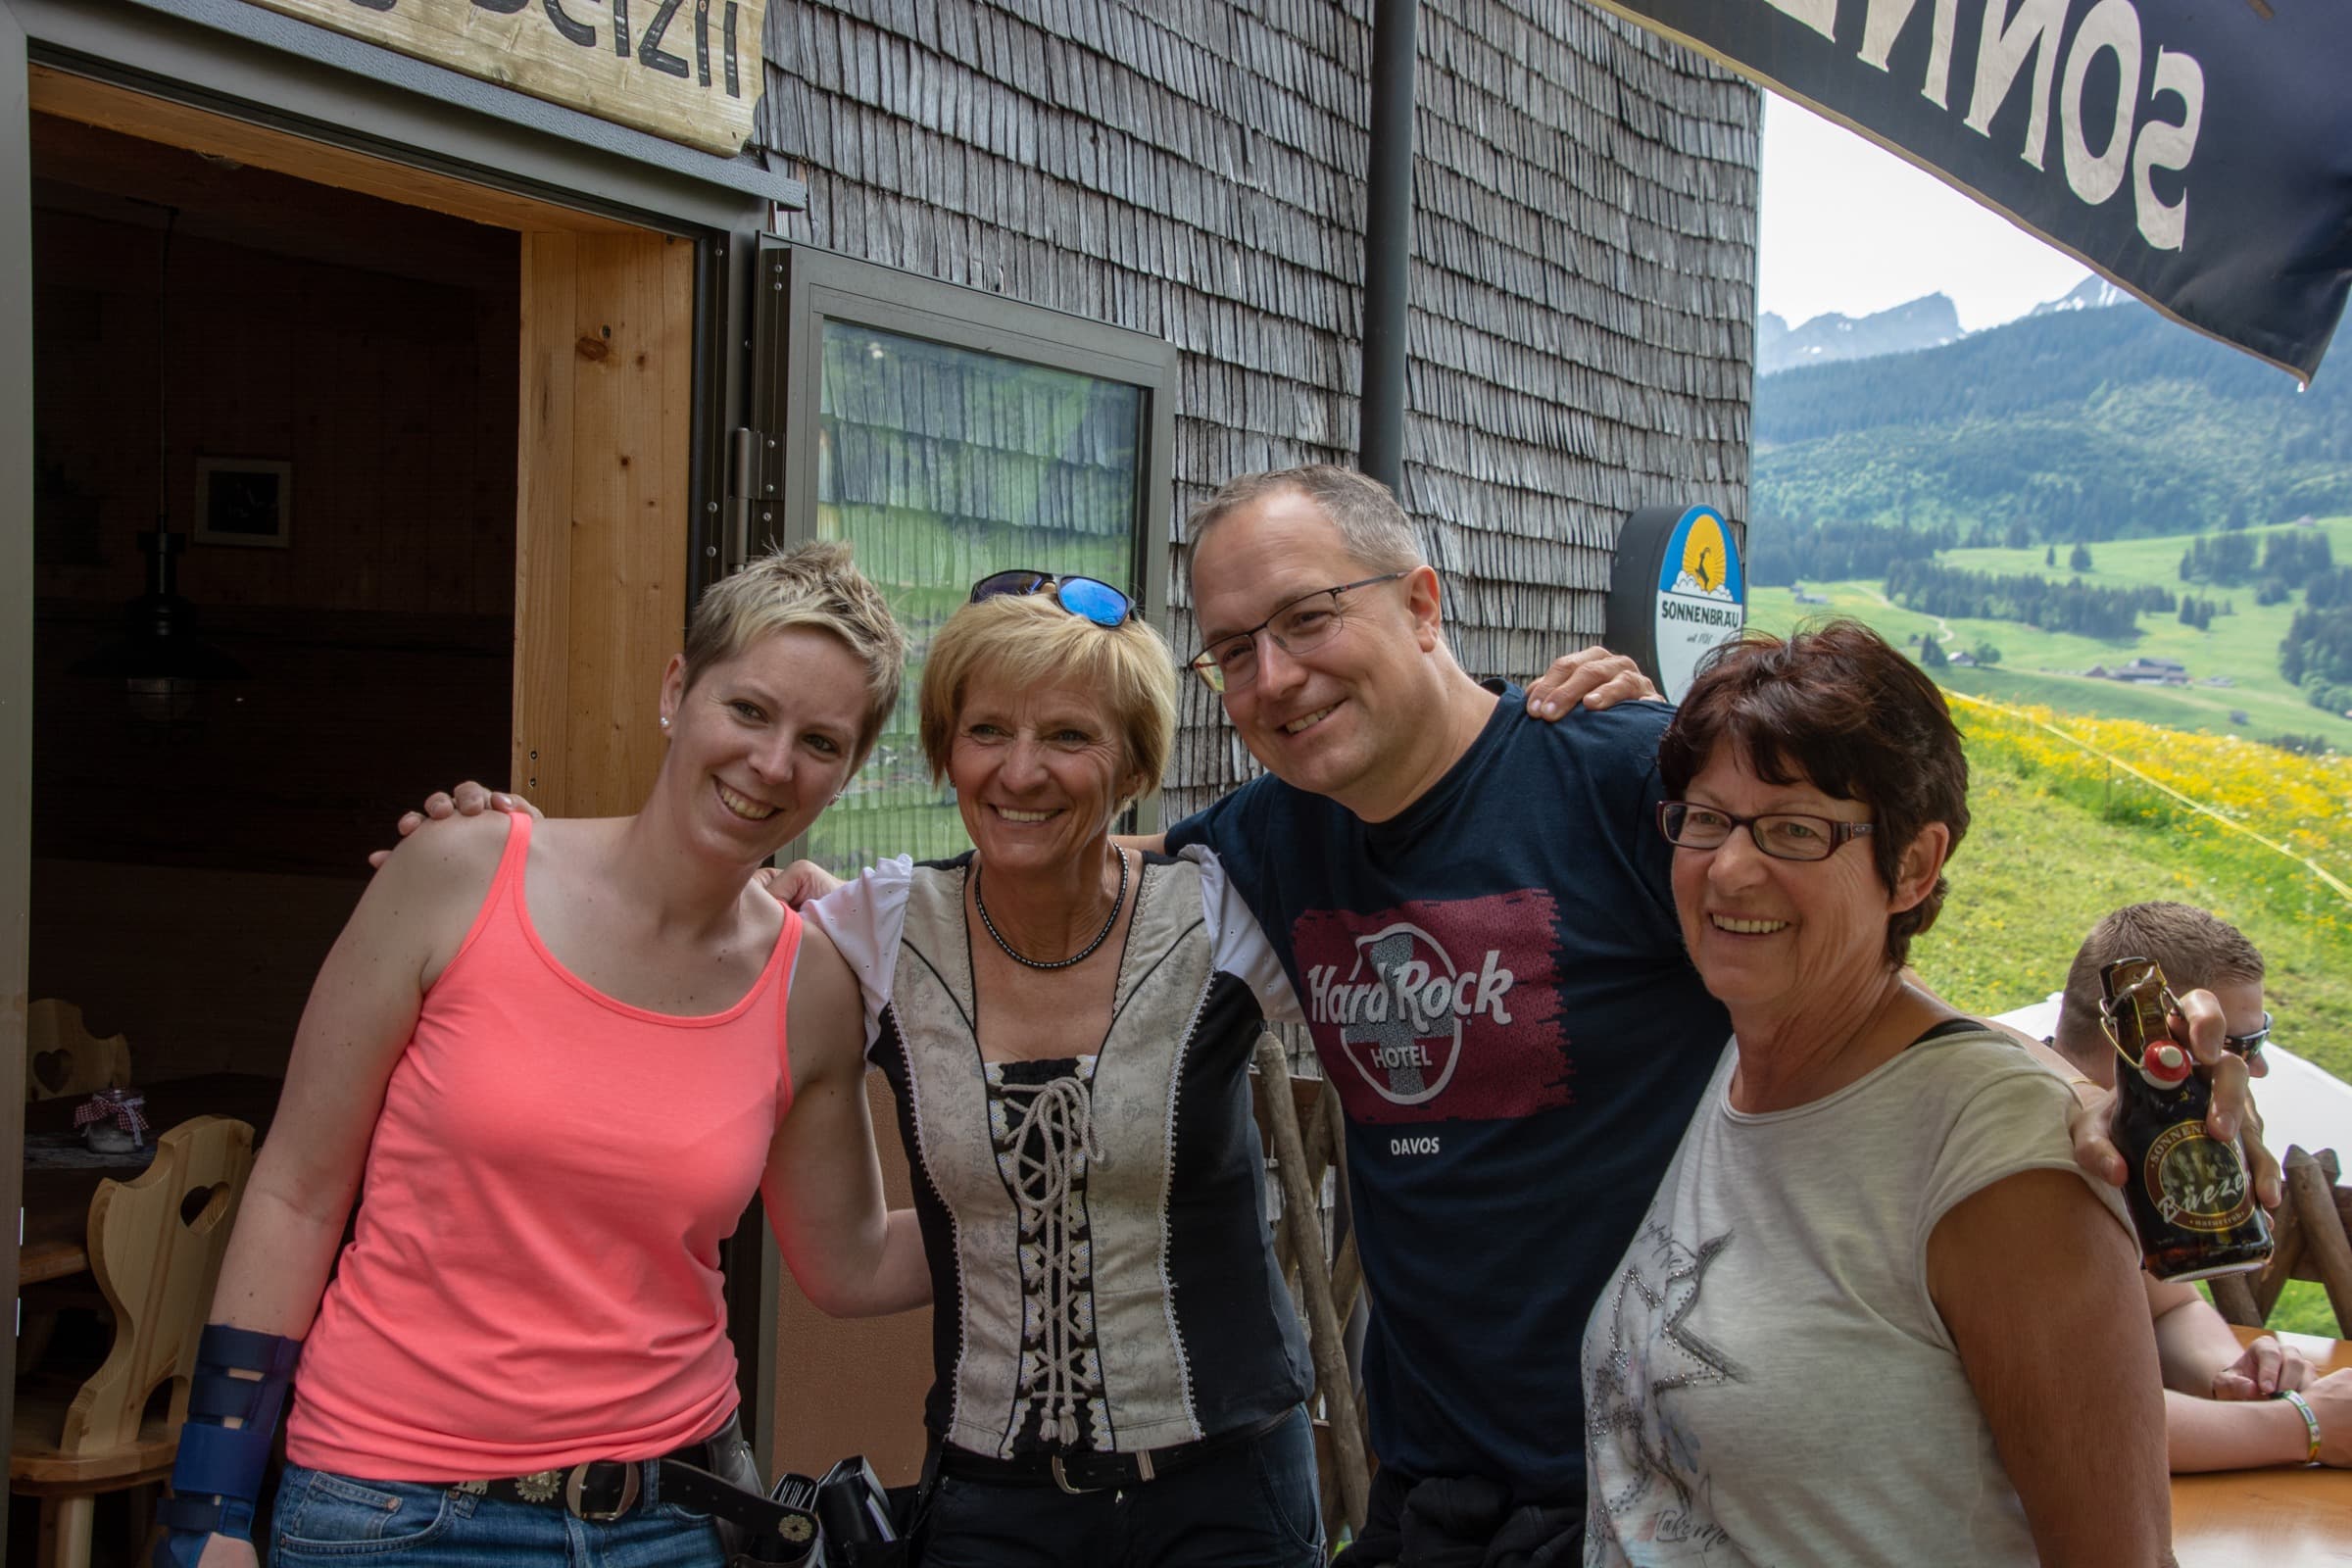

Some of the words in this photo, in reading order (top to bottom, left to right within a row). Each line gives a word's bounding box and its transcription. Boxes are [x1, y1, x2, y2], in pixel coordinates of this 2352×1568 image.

[1661, 600, 1740, 628] SONNENBRÄU
[1307, 960, 1391, 1025] Hard
[1392, 949, 1514, 1033] Rock
[1370, 1046, 1434, 1069] HOTEL
[1391, 1137, 1441, 1155] DAVOS
